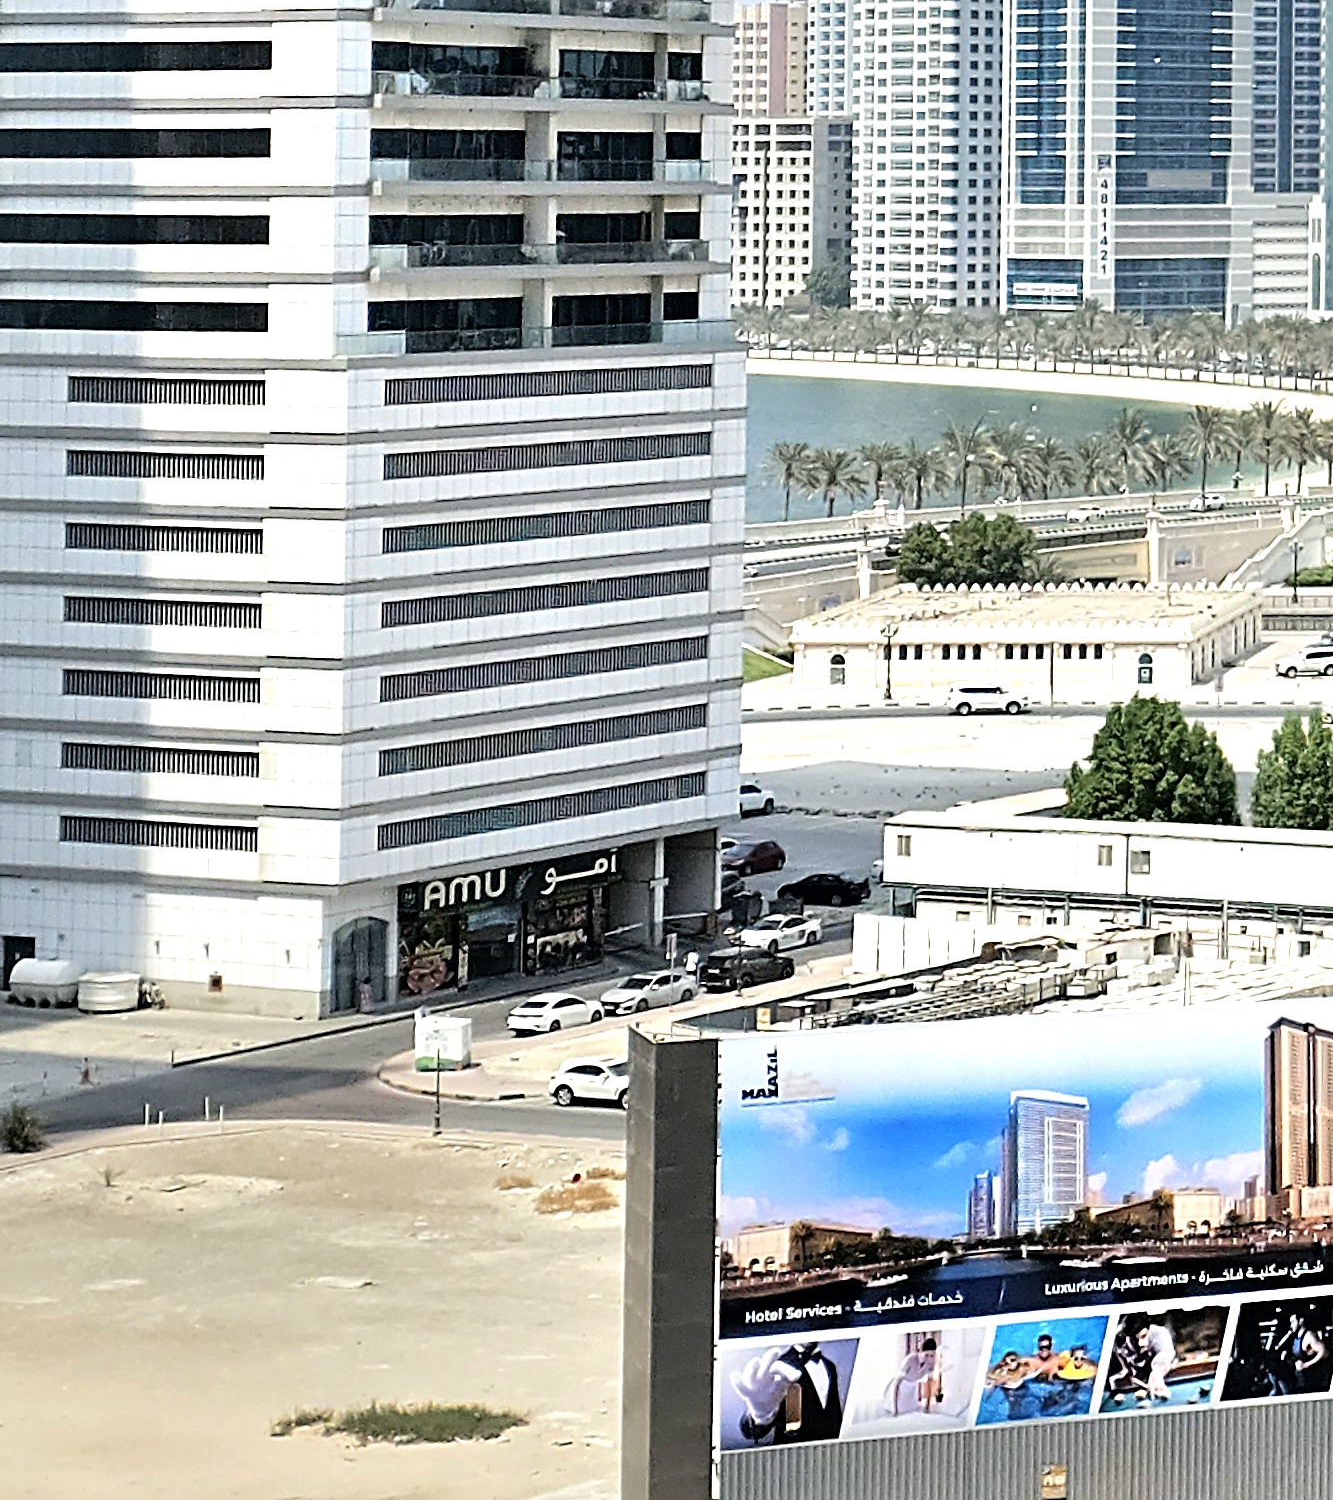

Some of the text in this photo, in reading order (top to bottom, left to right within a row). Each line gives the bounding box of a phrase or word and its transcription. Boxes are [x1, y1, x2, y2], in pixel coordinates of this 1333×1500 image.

[423, 869, 506, 910] AMU
[1044, 1279, 1109, 1296] Luxurious
[1110, 1273, 1190, 1292] Apartments
[745, 1308, 782, 1324] Hotel
[785, 1303, 843, 1320] Services
